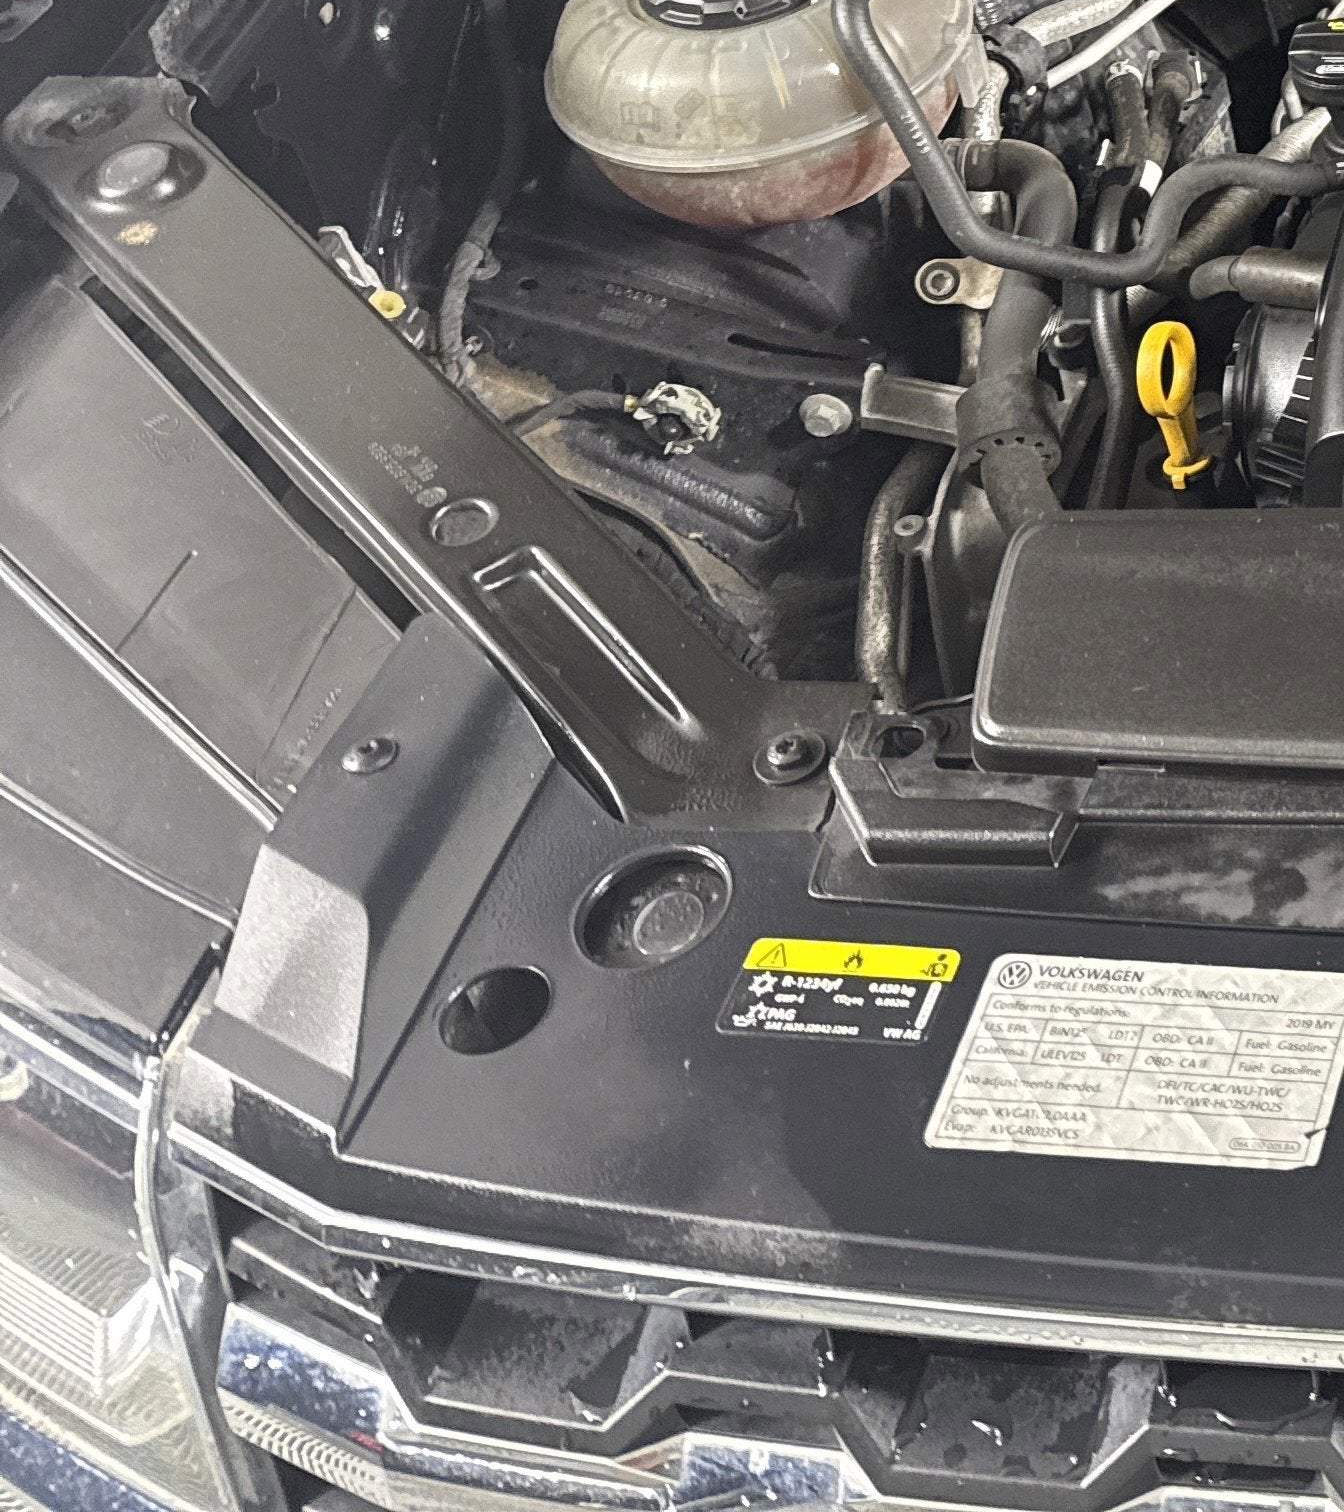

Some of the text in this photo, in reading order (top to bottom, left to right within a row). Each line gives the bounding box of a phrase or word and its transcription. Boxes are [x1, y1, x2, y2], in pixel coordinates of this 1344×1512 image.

[1038, 964, 1144, 983] VOLKSWAGEN
[1034, 982, 1279, 1003] VEHICLE EMISSION CONTROL INFORMATION
[993, 999, 1046, 1013] Conforms
[1050, 1001, 1062, 1012] to
[767, 1007, 797, 1021] PAG
[1286, 1018, 1335, 1030] 2019 MY
[883, 1027, 922, 1040] VW AG
[1187, 1034, 1204, 1045] CA
[1277, 1040, 1328, 1053] Gasoline
[1101, 1052, 1124, 1063] LDT
[1179, 1057, 1196, 1069] CA
[1270, 1064, 1322, 1077] Gasoline
[963, 1074, 981, 1085] No
